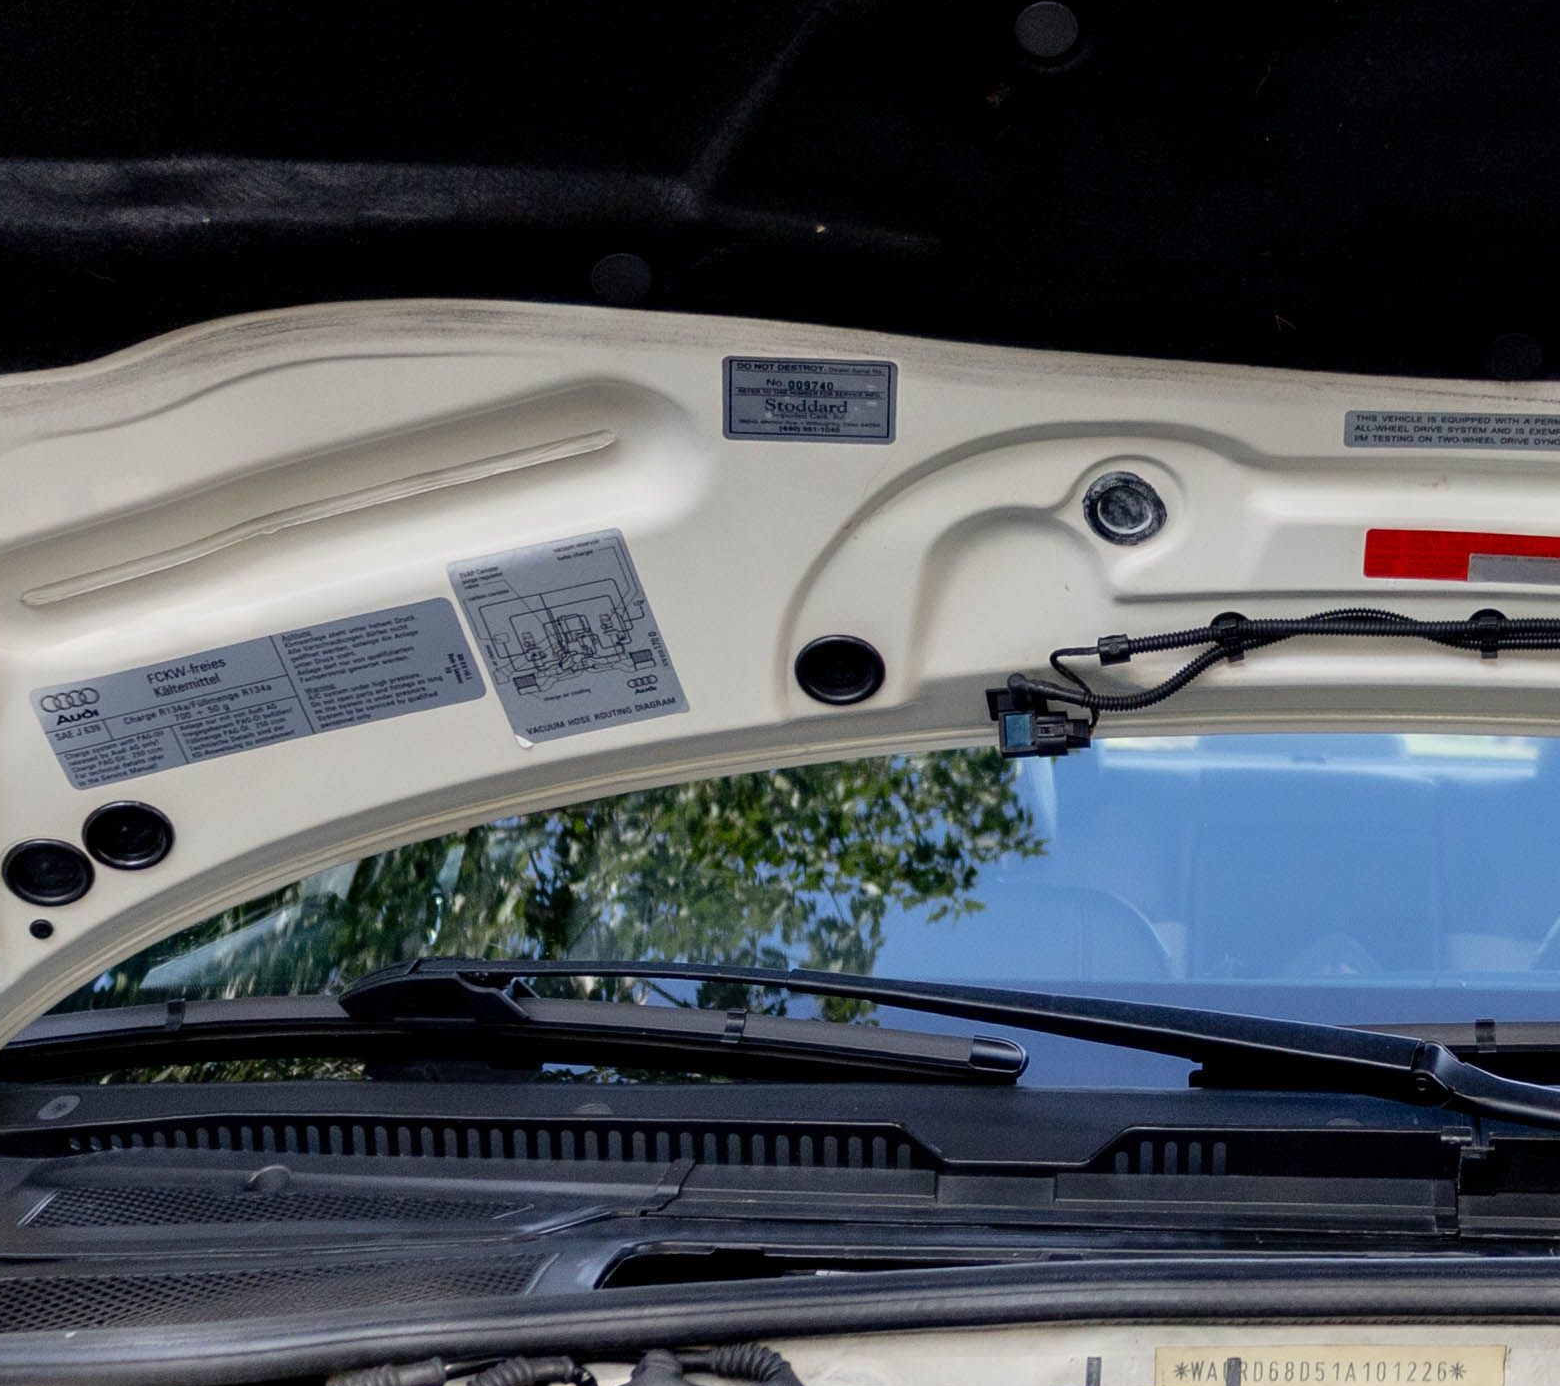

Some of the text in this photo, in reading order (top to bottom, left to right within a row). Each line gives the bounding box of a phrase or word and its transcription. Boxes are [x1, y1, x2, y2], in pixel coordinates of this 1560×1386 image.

[788, 380, 833, 390] 009740
[764, 398, 847, 413] Stoddard
[1354, 424, 1408, 432] ALL-WHEEL
[1381, 414, 1422, 422] VEHICLE
[1427, 415, 1436, 423] IS
[1440, 416, 1490, 424] EQUIPPED
[1523, 417, 1529, 425] A
[1372, 434, 1413, 442] TESTING
[1437, 435, 1496, 444] TWO-WHEEL
[145, 655, 228, 685] FCKW-freies
[151, 672, 222, 698] Kältemittel
[53, 705, 100, 726] Audi
[525, 695, 676, 735] VACUUM HOSE ROUTING DIAGRAM
[1173, 1359, 1466, 1382] WARD68D51A101226
